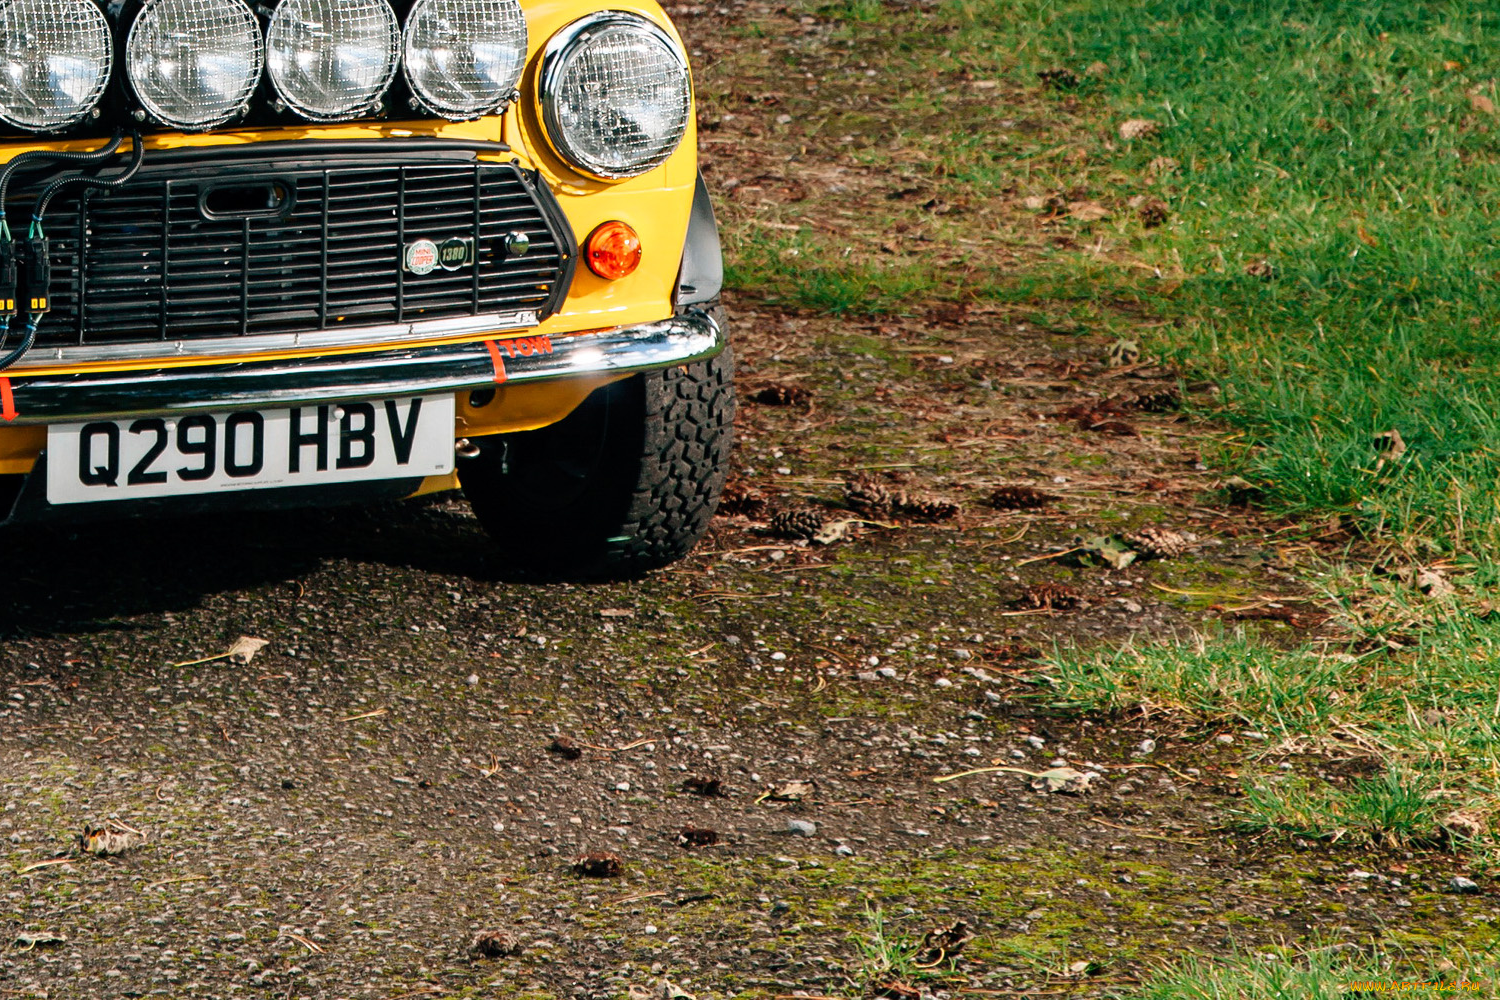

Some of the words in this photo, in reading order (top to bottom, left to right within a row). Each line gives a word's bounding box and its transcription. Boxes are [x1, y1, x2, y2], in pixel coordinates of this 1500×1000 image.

[410, 255, 434, 266] COOPER
[442, 246, 465, 262] 1380
[498, 336, 554, 358] TOW
[78, 411, 265, 487] Q290
[288, 398, 423, 474] HBV
